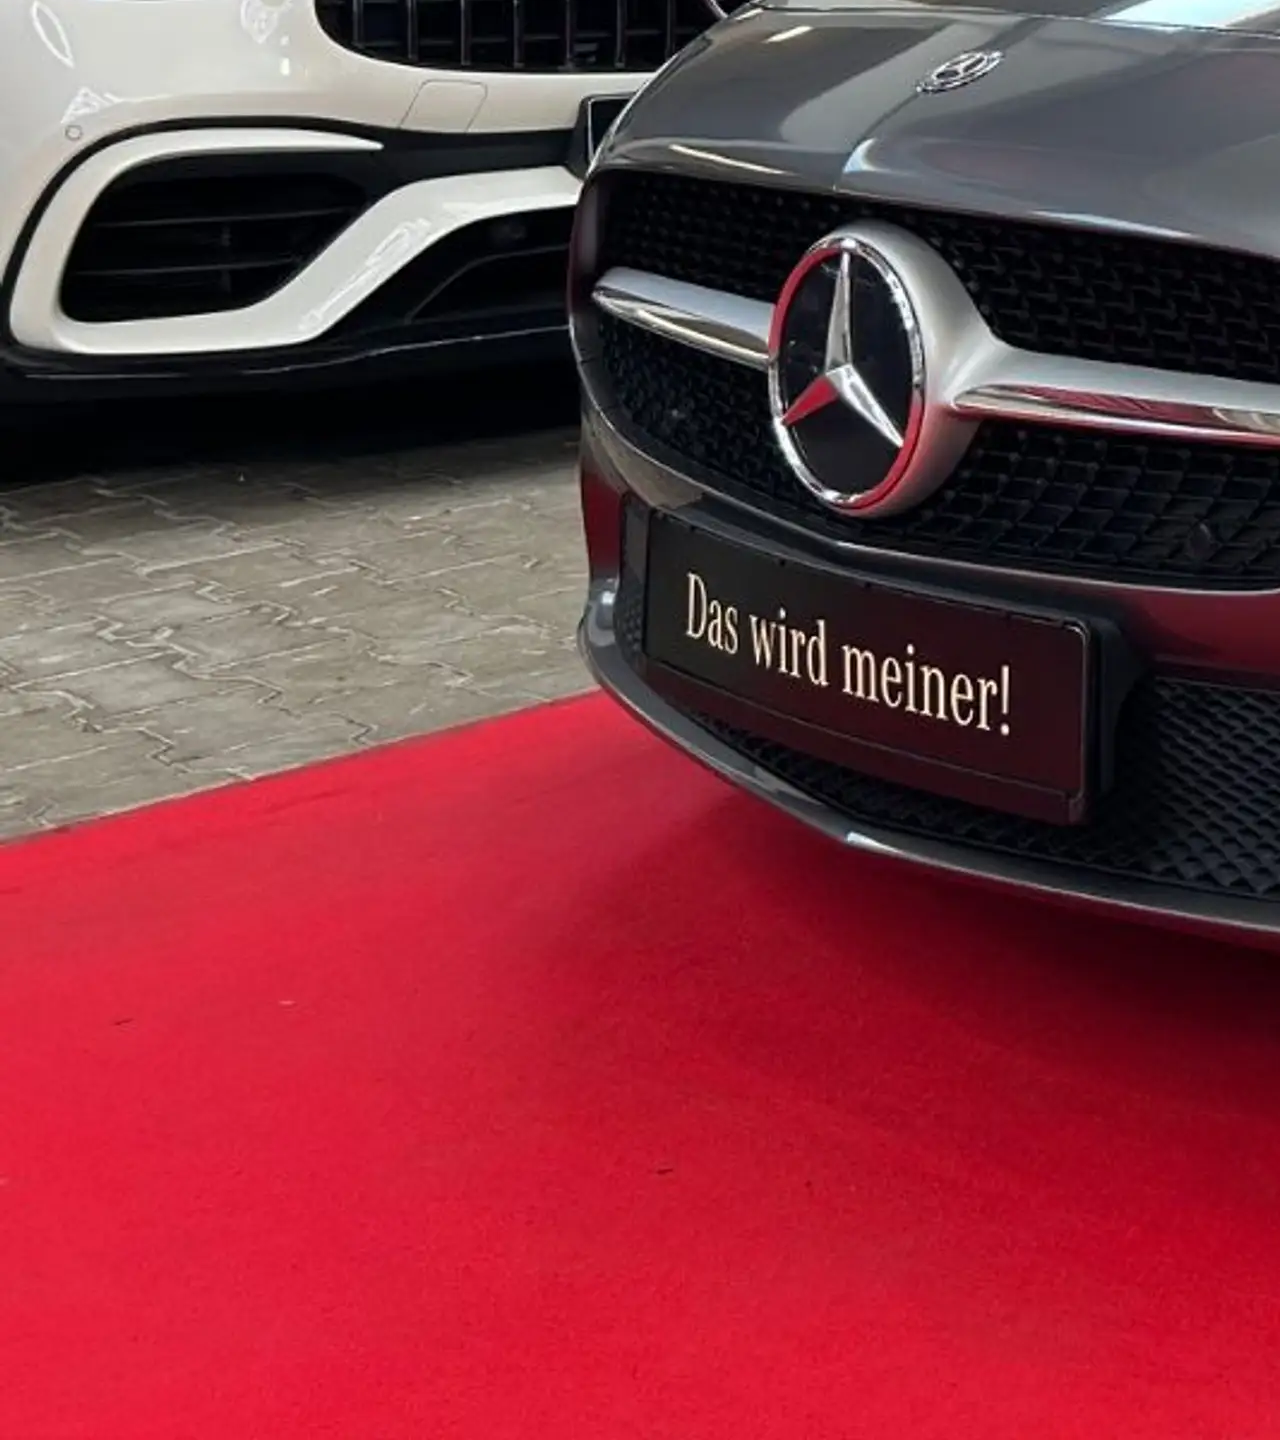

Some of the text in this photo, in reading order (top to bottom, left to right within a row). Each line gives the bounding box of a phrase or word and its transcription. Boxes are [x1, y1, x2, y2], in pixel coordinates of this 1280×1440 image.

[685, 571, 1011, 737] Das wird meiner!
